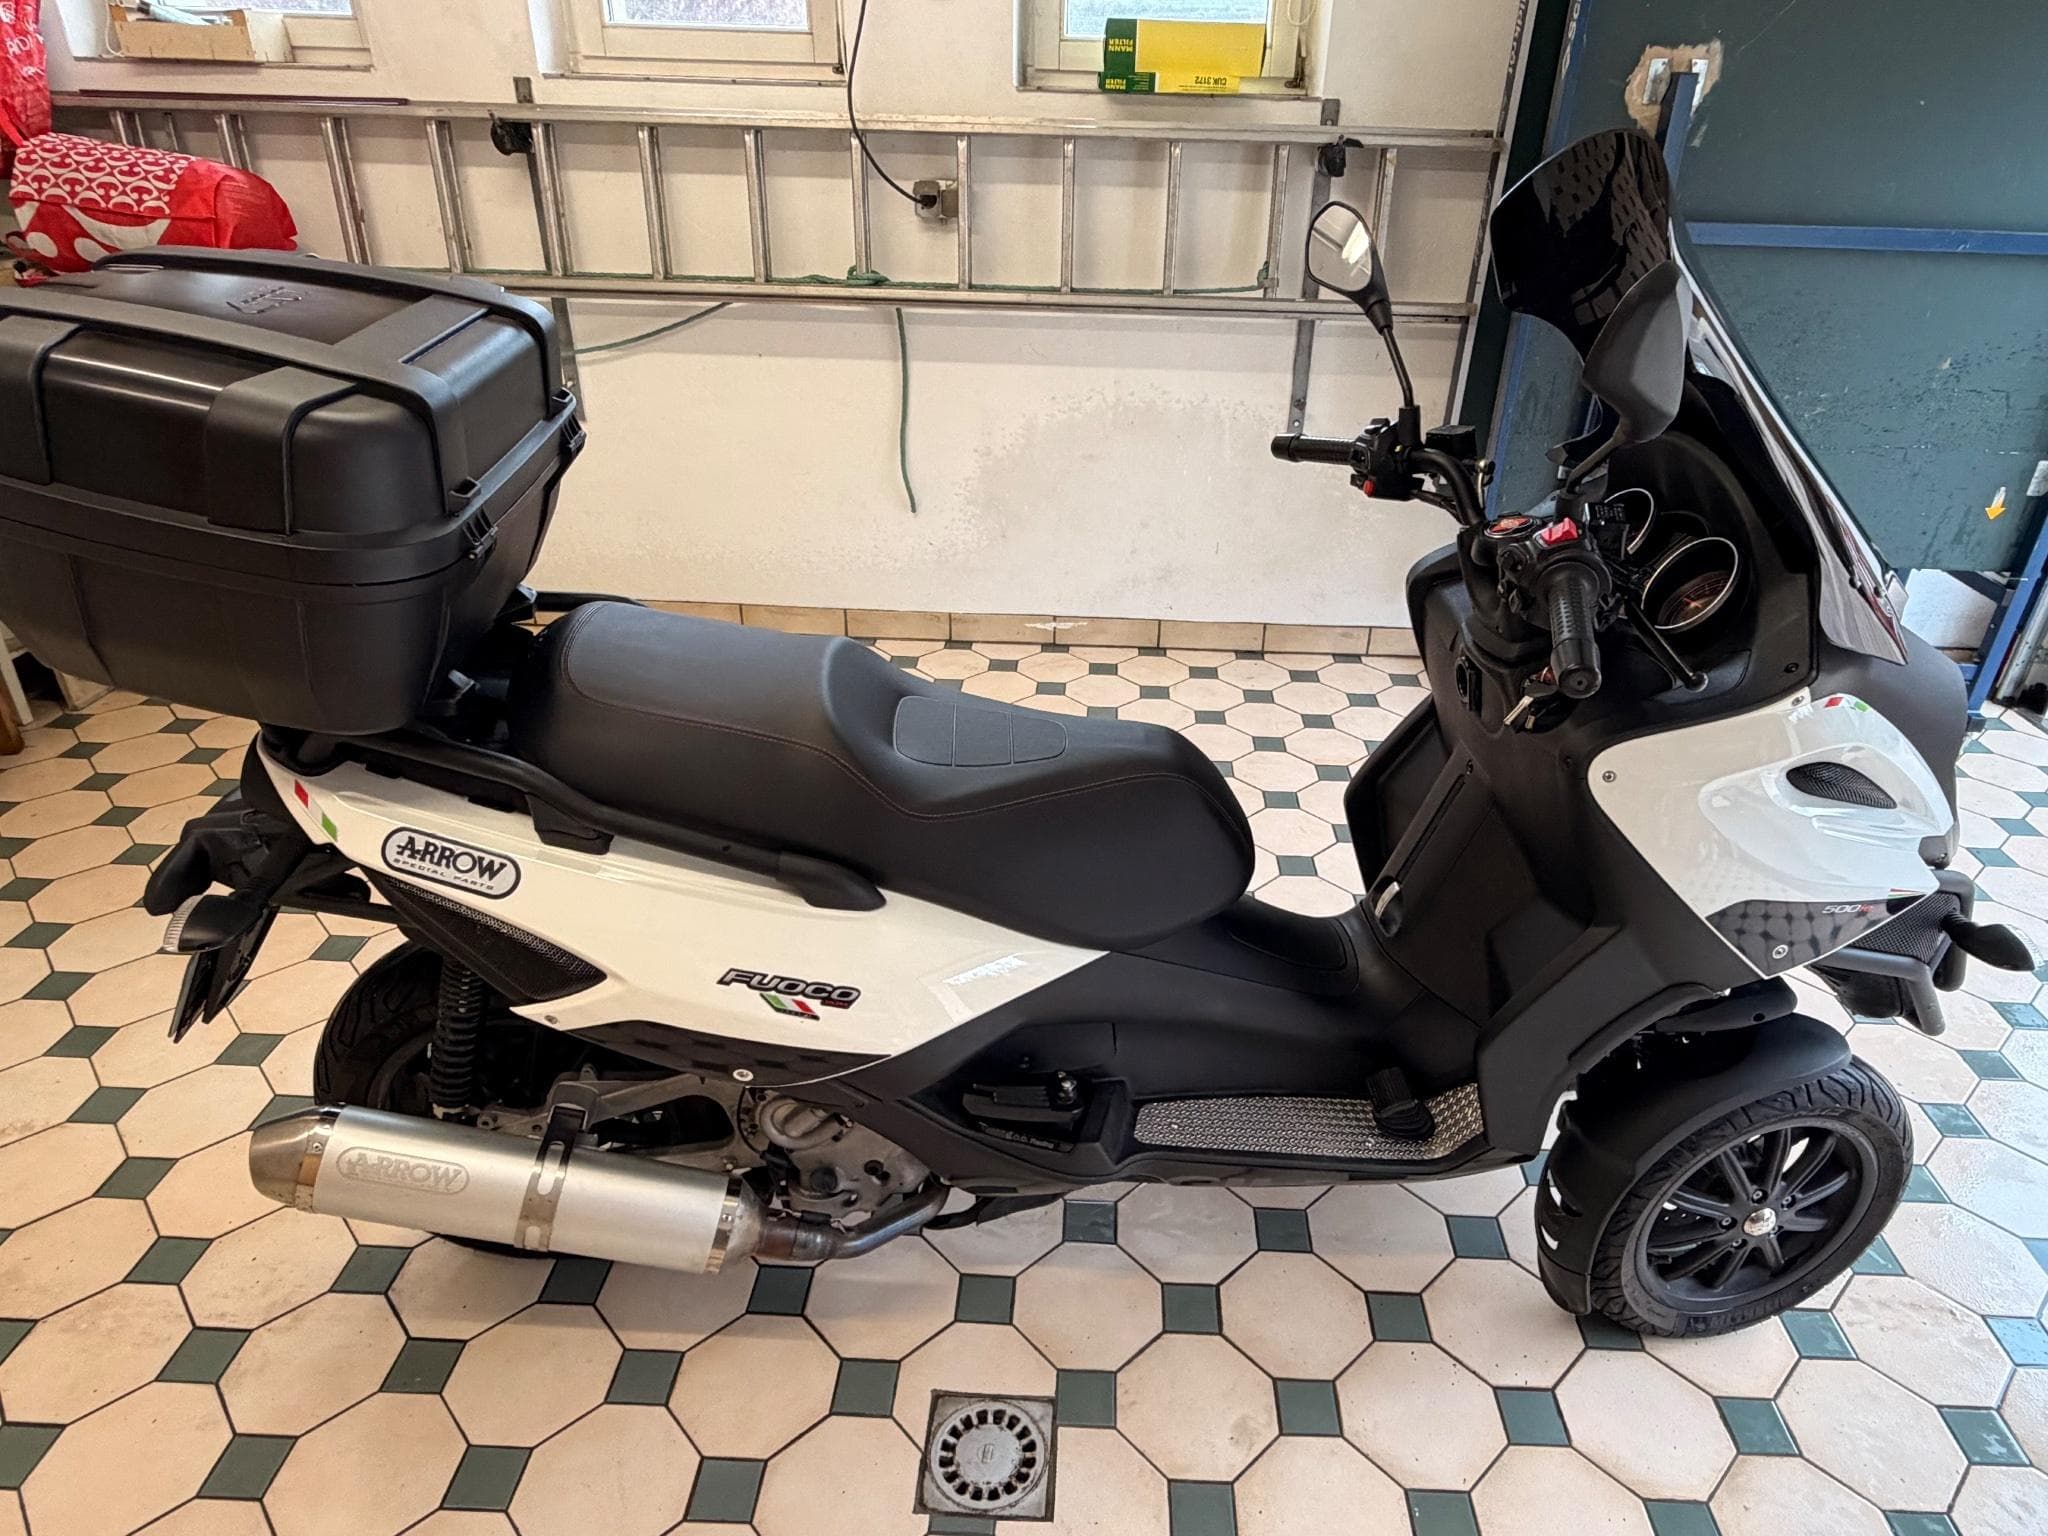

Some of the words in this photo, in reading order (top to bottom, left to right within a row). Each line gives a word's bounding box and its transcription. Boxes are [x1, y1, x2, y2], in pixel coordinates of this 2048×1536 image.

[1109, 45, 1133, 53] MANN
[1194, 76, 1212, 86] 3172
[393, 858, 448, 878] SPECIAL
[453, 875, 496, 891] PARTS
[396, 835, 507, 882] ARROW
[716, 967, 862, 1002] FUOCO
[344, 1151, 463, 1193] ARROW
